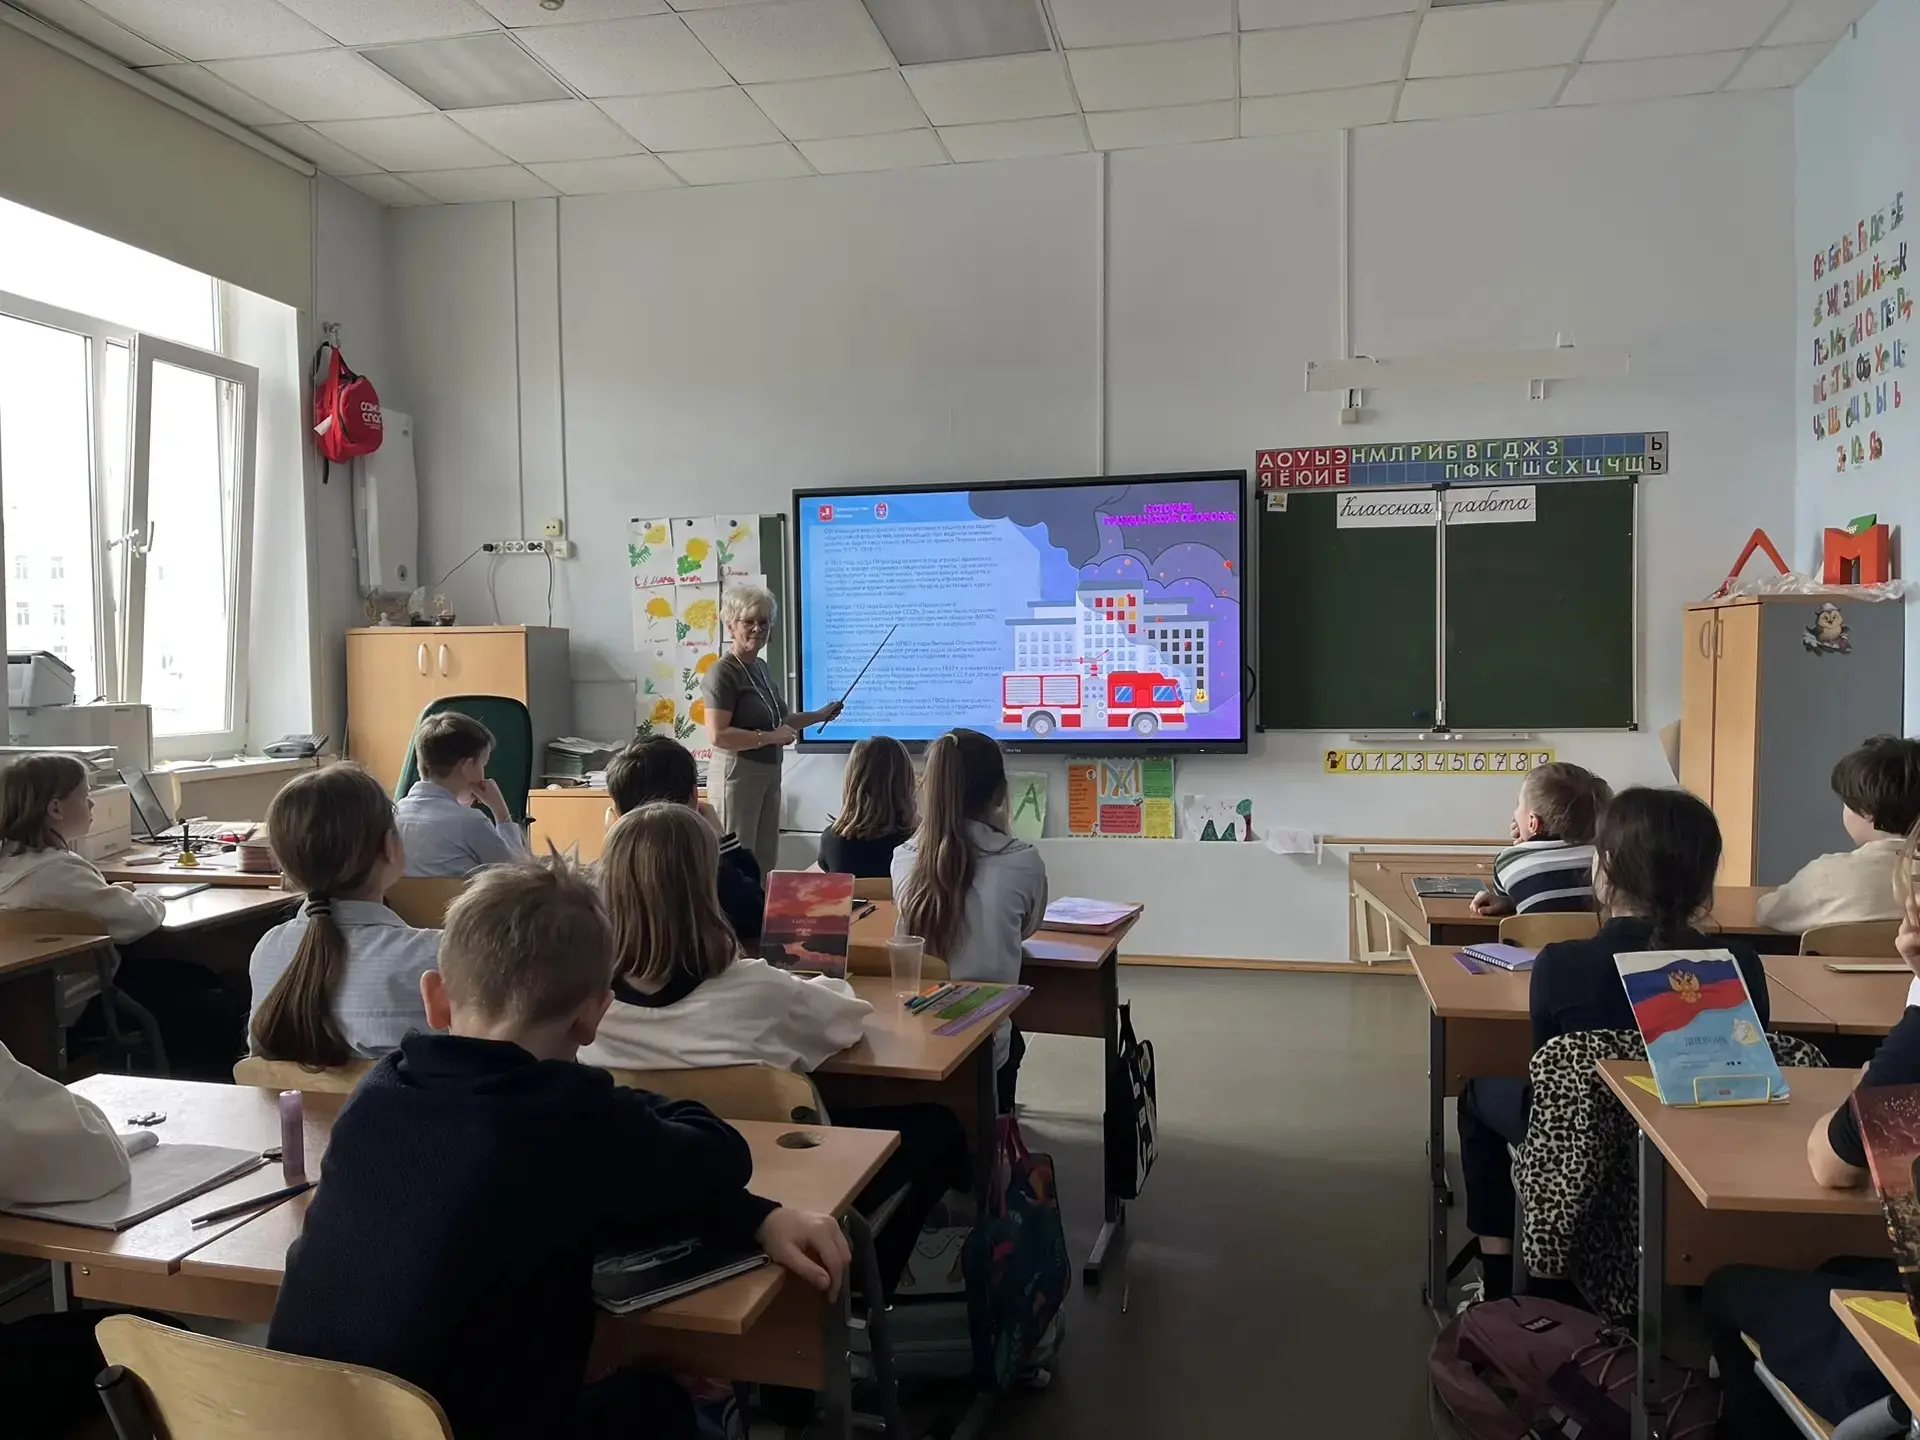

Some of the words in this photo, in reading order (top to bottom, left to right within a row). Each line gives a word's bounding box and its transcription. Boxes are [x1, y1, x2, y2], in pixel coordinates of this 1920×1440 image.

[1340, 496, 1433, 517] Классная
[1448, 489, 1532, 521] работа
[1351, 752, 1364, 770] 0
[1374, 752, 1383, 770] 1
[1391, 752, 1404, 770] 2
[1412, 752, 1424, 770] 3
[1434, 752, 1445, 770] 4
[1452, 752, 1466, 770] 5
[1474, 752, 1486, 770] 6
[1494, 752, 1507, 770] 7
[1516, 752, 1528, 770] 8
